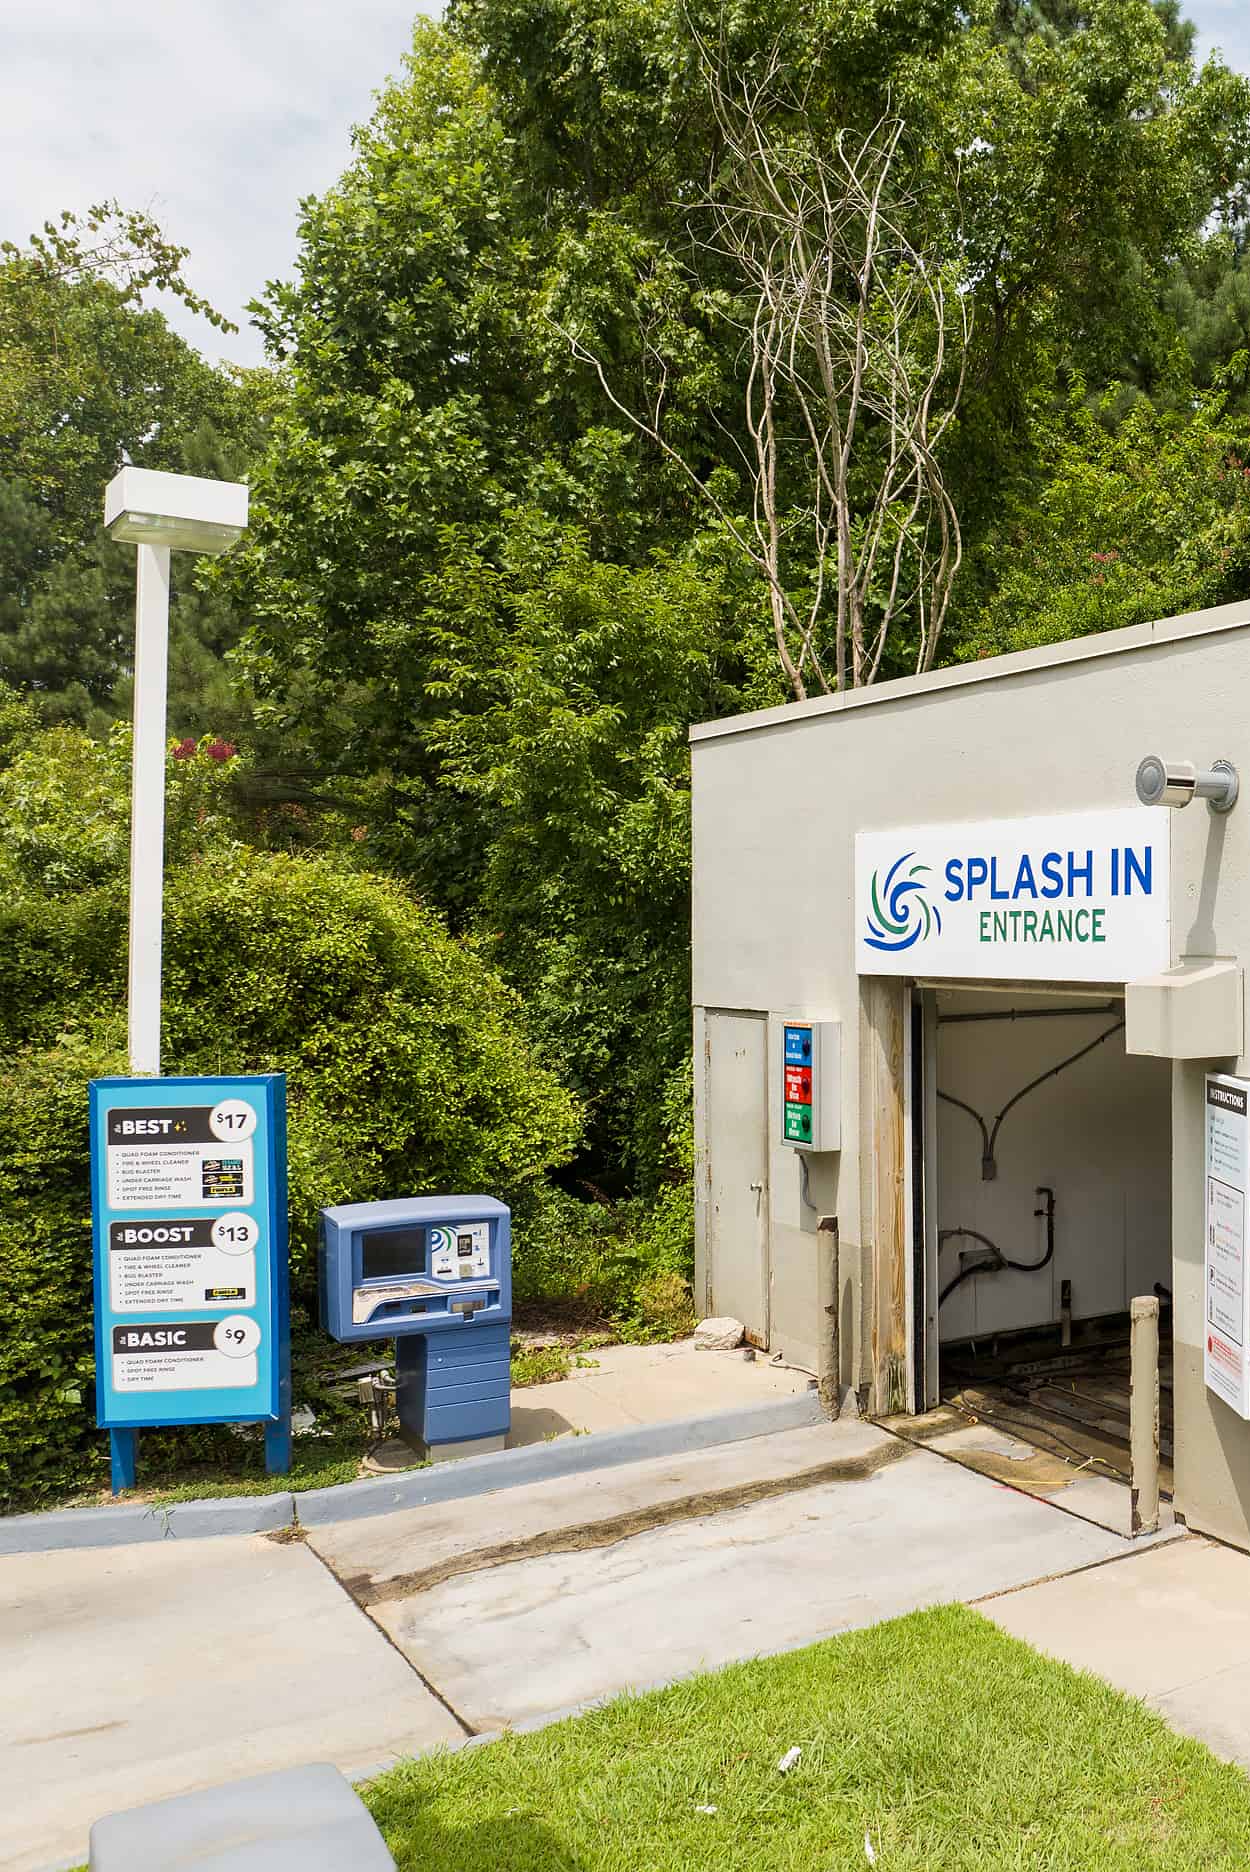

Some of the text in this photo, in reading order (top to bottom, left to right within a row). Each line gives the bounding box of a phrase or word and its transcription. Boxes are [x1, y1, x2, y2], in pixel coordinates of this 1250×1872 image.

[944, 846, 1152, 902] SPLASH IN
[979, 908, 1106, 943] ENTRANCE
[1209, 1087, 1244, 1109] INSTRUCTIONS
[122, 1119, 173, 1135] BEST
[216, 1113, 247, 1129] $17
[124, 1227, 194, 1244] BOOST
[218, 1226, 249, 1242] $13
[127, 1330, 187, 1347] BASIC
[225, 1329, 245, 1345] $9
